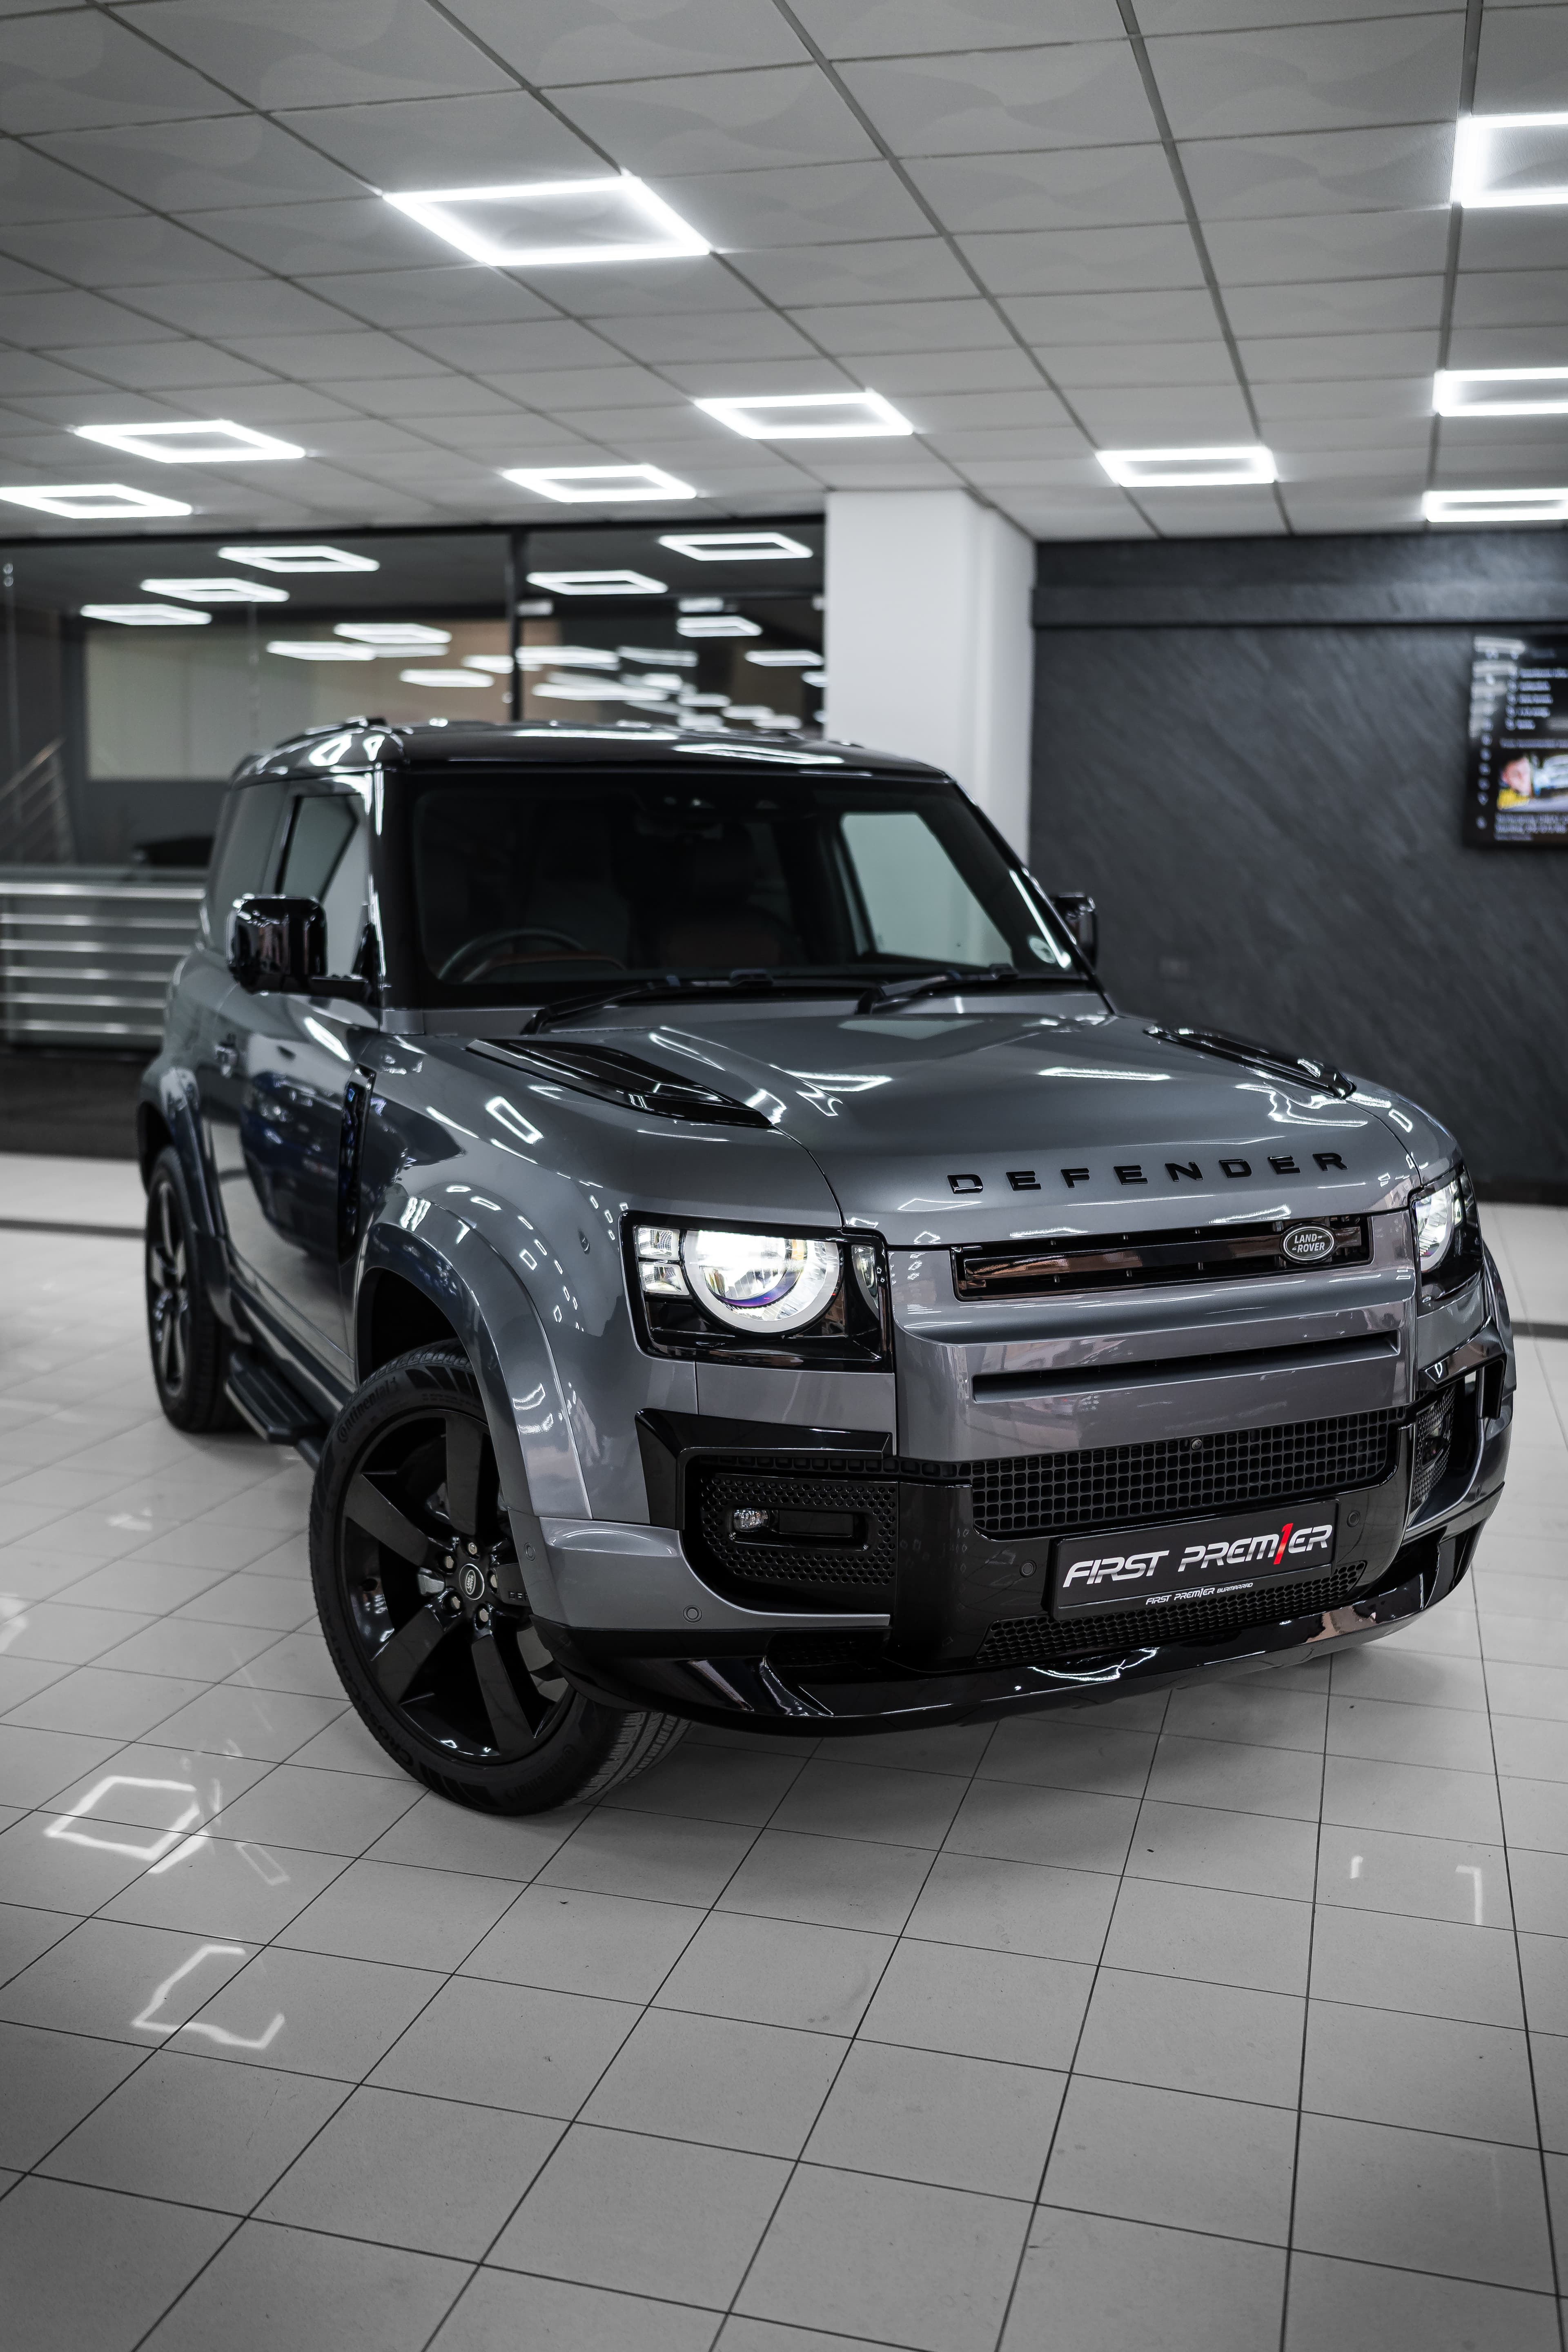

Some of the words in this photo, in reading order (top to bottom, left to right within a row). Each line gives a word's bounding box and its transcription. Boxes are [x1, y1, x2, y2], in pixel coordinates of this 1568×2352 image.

[947, 1152, 1349, 1195] DEFENDER
[1294, 1234, 1317, 1244] LAND
[1297, 1242, 1325, 1253] ROVER
[337, 1379, 390, 1443] Continental
[1062, 1550, 1169, 1588] FIRST
[1145, 1595, 1172, 1605] FIRST
[1217, 1582, 1253, 1593] BURMARRAD
